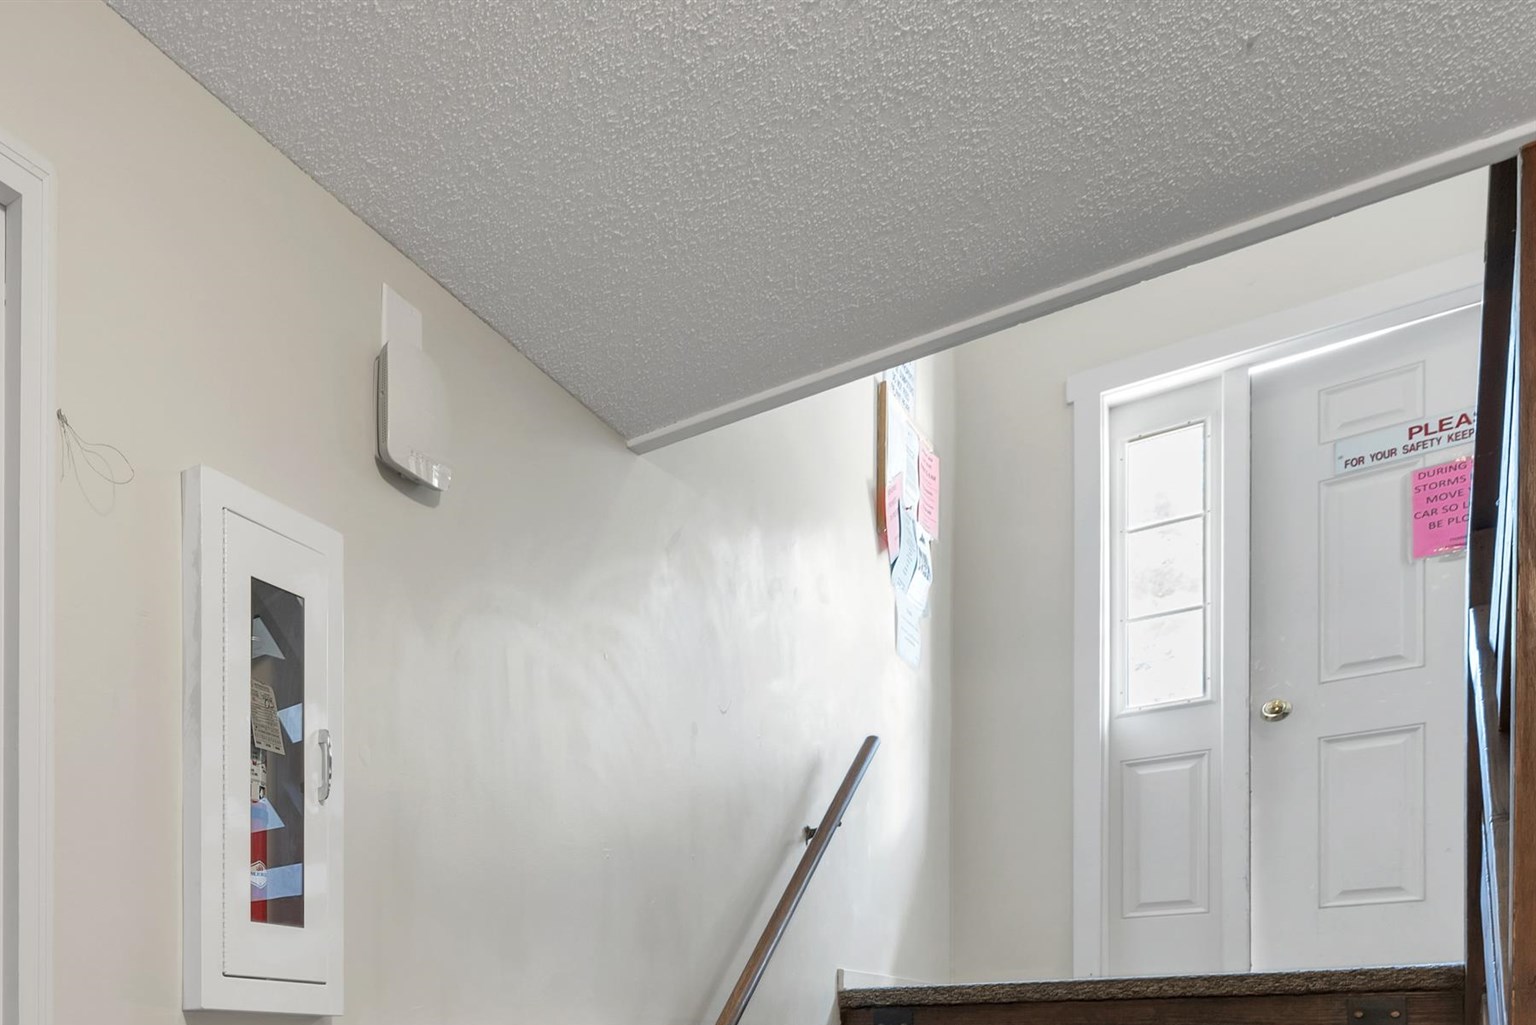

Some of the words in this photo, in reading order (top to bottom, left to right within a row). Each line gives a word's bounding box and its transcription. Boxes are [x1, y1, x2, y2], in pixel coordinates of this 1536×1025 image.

[1408, 413, 1476, 440] PLEA
[1344, 456, 1365, 469] FOR
[1369, 447, 1397, 462] YOUR
[1402, 436, 1442, 454] SAFETY
[1447, 428, 1474, 443] KEEP
[1418, 461, 1467, 480] DURING
[1414, 475, 1467, 494] STORMS
[1426, 488, 1464, 504] MOVE
[1413, 508, 1438, 520] CAR
[1441, 503, 1459, 514] SO
[1428, 519, 1444, 530] BE
